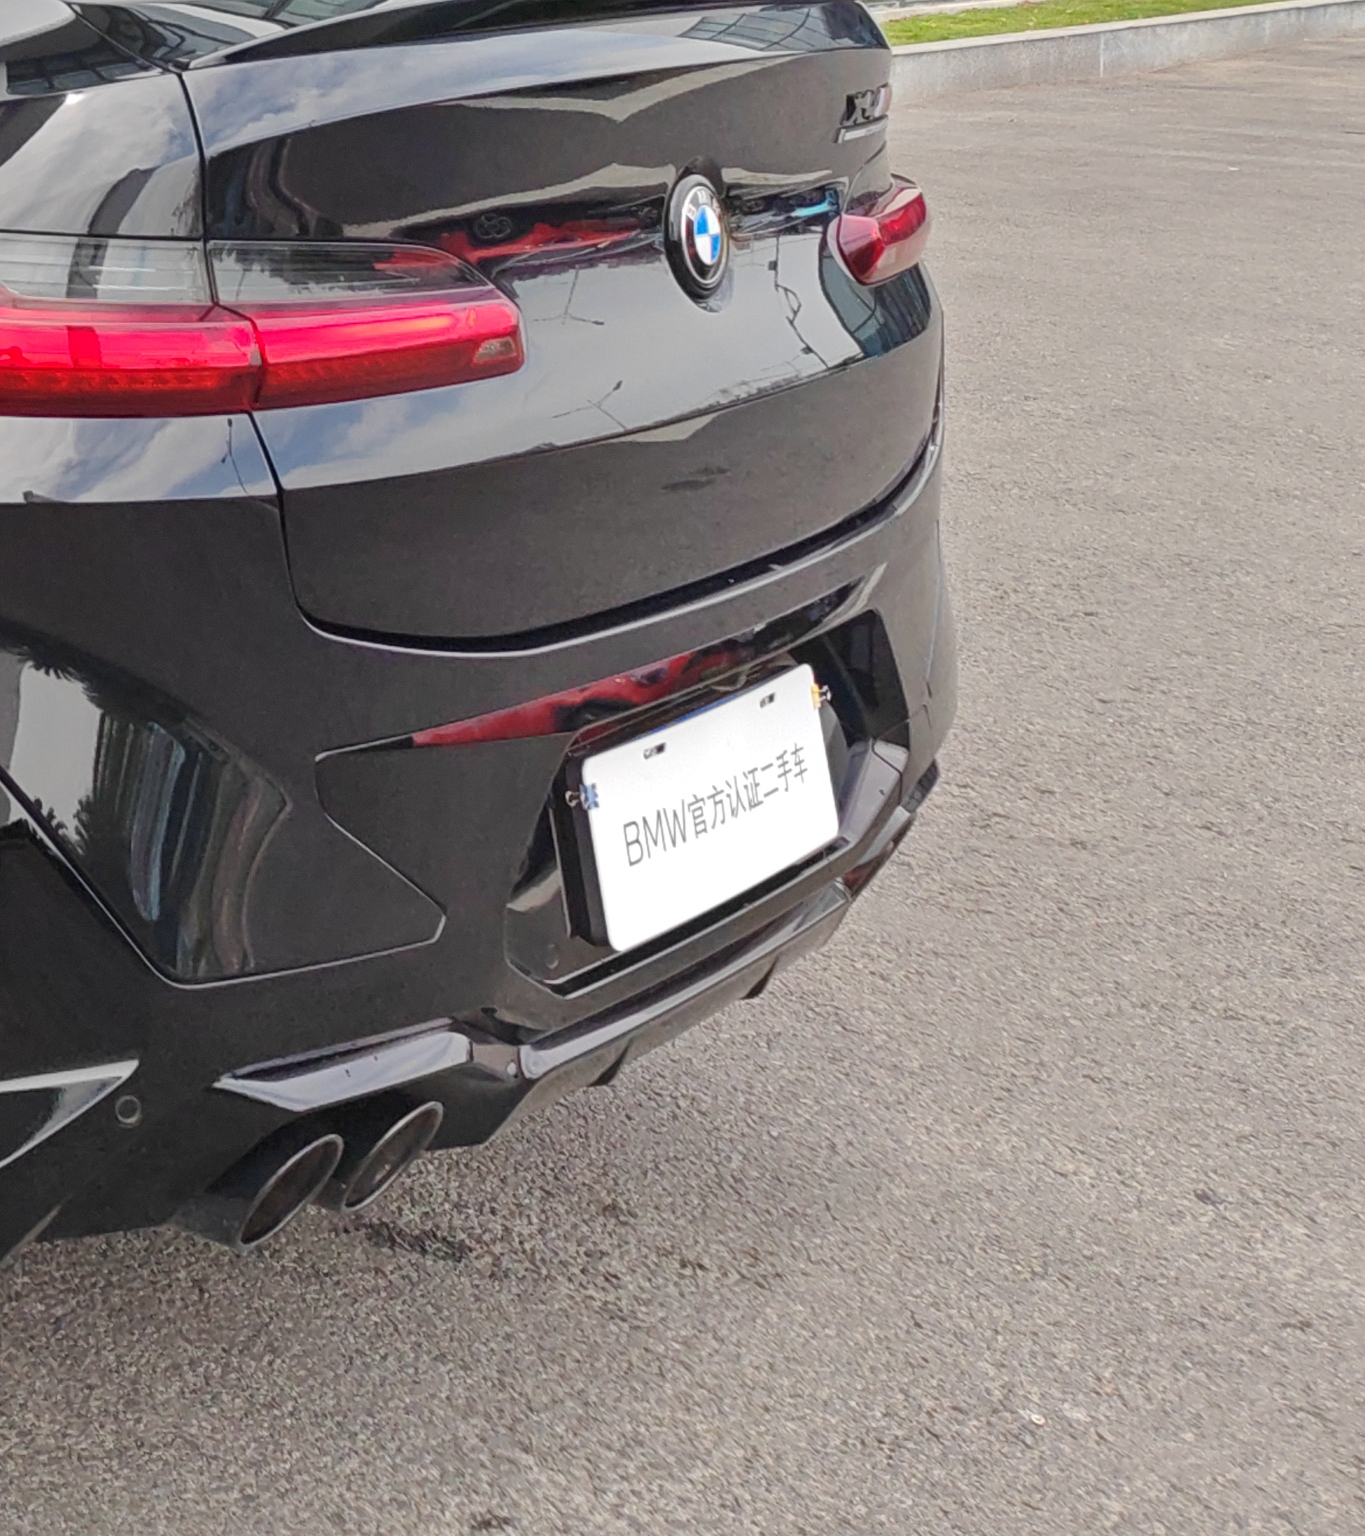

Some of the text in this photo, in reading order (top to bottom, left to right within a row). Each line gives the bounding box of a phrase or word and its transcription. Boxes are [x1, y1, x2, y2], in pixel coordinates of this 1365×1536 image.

[623, 742, 809, 867] BMW官方认证二手车
